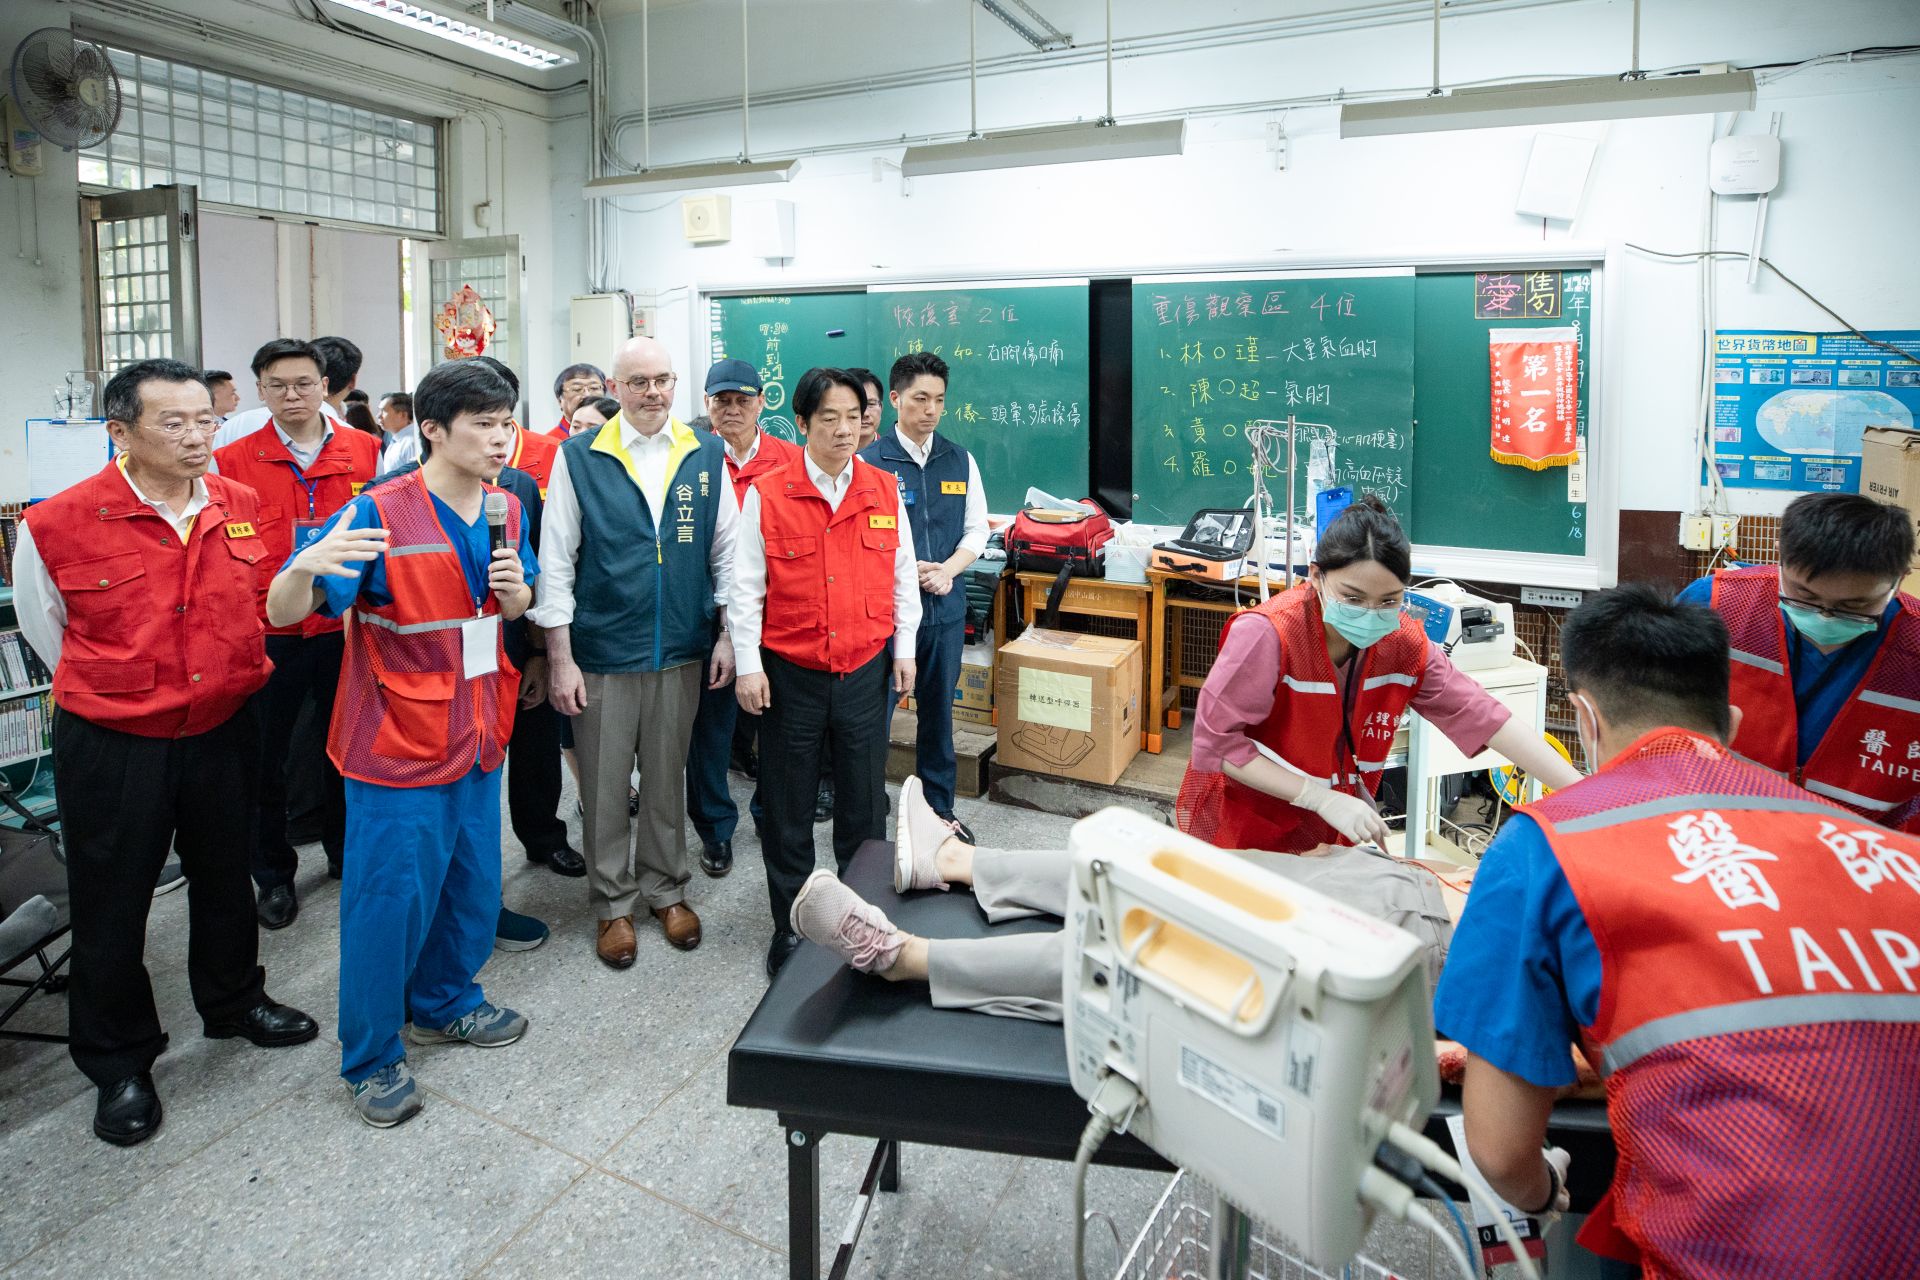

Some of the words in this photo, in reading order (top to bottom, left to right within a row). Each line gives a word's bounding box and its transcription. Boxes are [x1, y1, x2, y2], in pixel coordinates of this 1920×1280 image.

[1151, 292, 1289, 326] 重傷觀察區
[1482, 274, 1521, 311] 愛
[893, 301, 961, 329] 恢復室
[1717, 338, 1808, 352] 世界貨幣地圖
[1519, 354, 1552, 433] 第一名
[676, 484, 695, 543] 谷立言
[1716, 926, 1920, 994] TAIP
